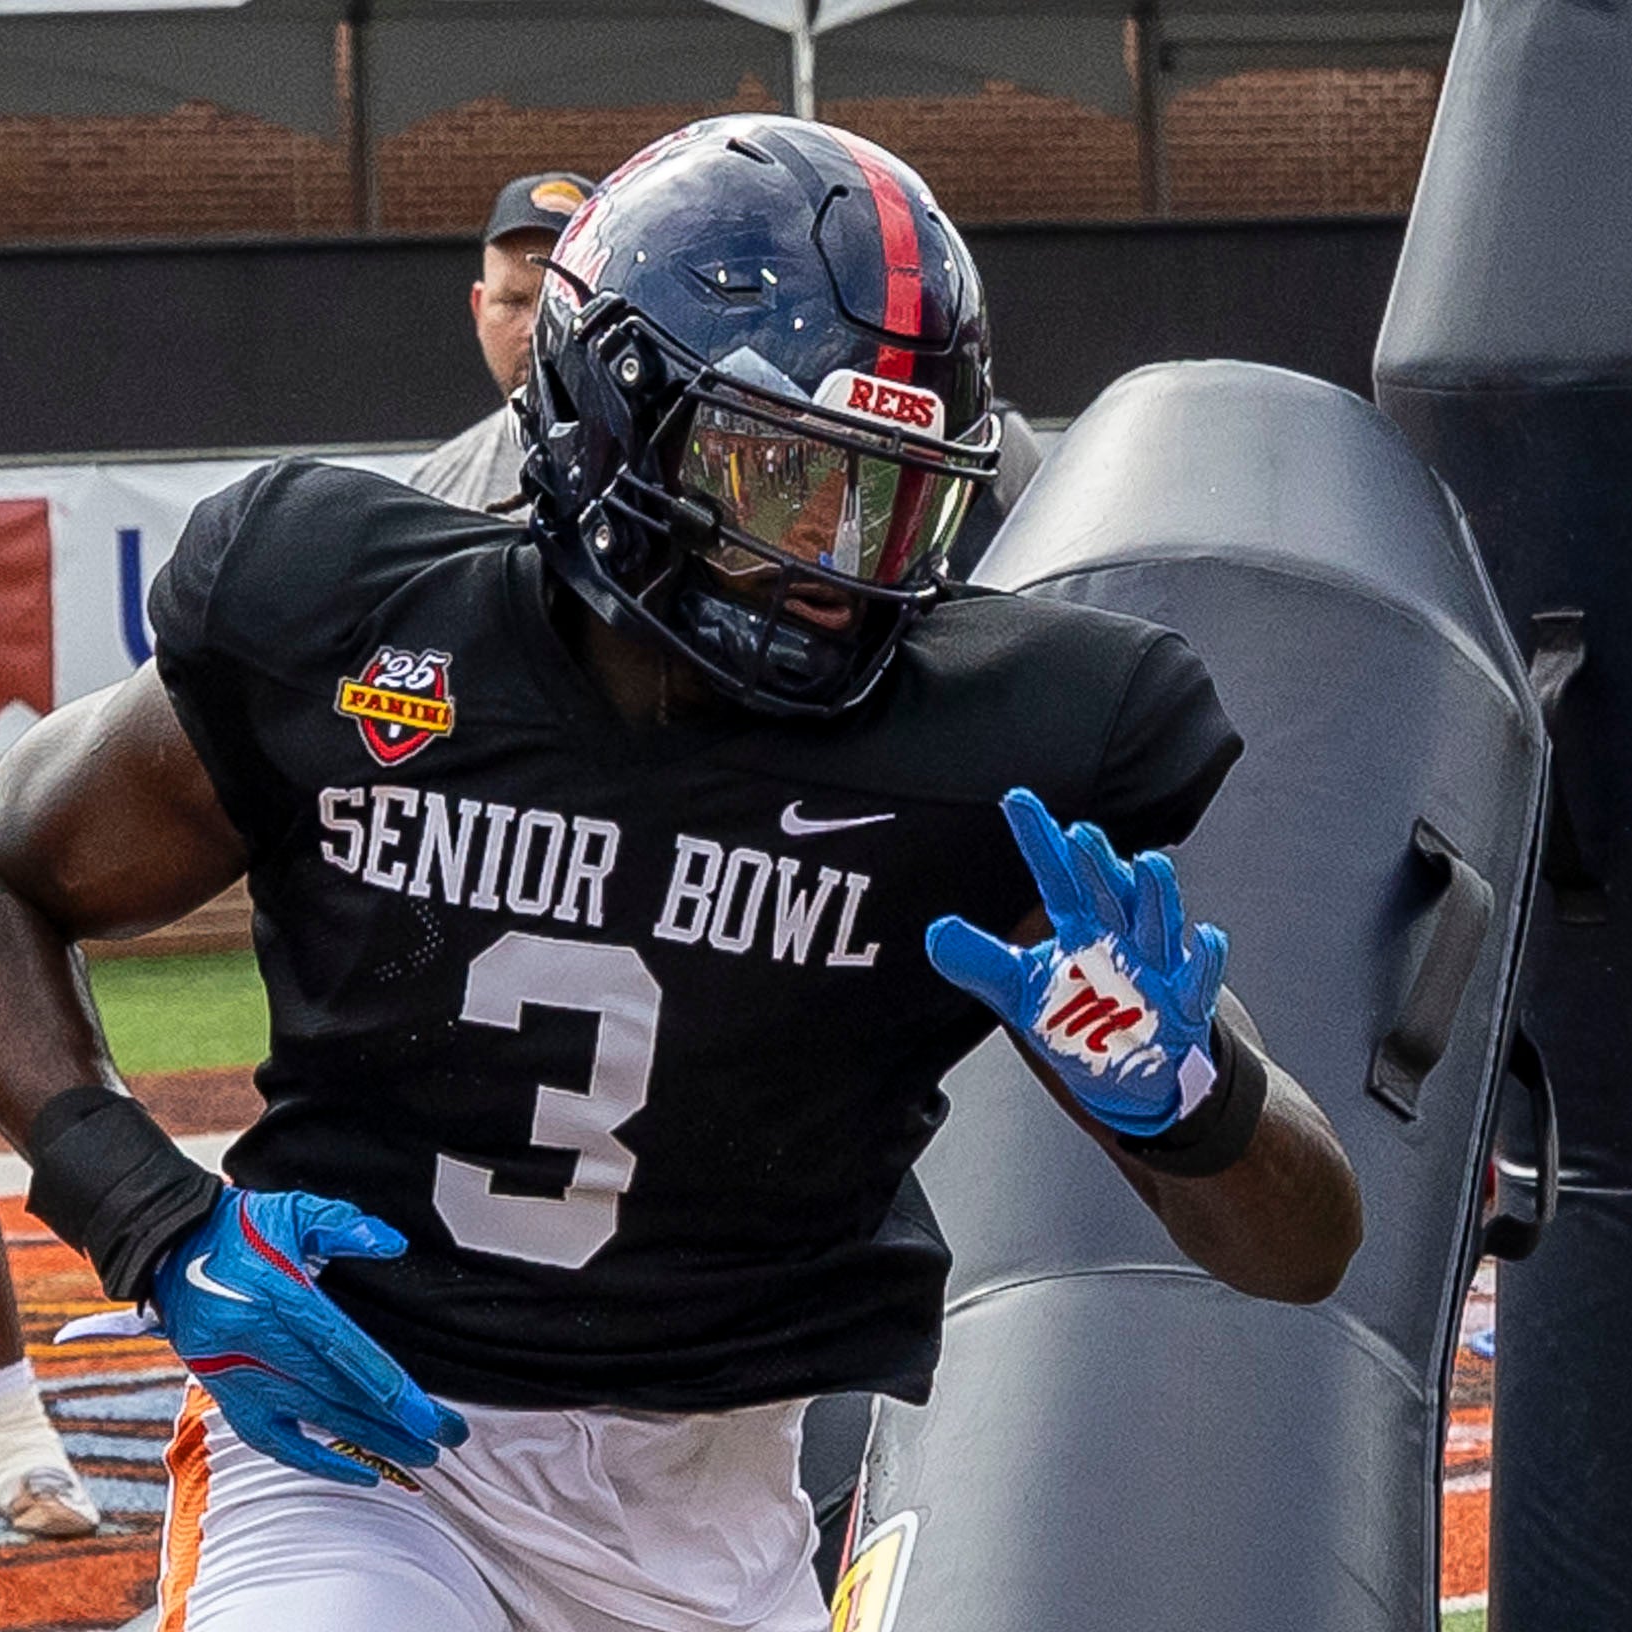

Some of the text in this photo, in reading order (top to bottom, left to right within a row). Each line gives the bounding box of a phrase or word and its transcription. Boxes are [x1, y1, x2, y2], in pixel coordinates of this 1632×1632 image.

[847, 377, 937, 428] REBS
[347, 690, 452, 725] PANINI
[318, 785, 881, 967] SENIOR BOWL
[432, 931, 662, 1269] 3
